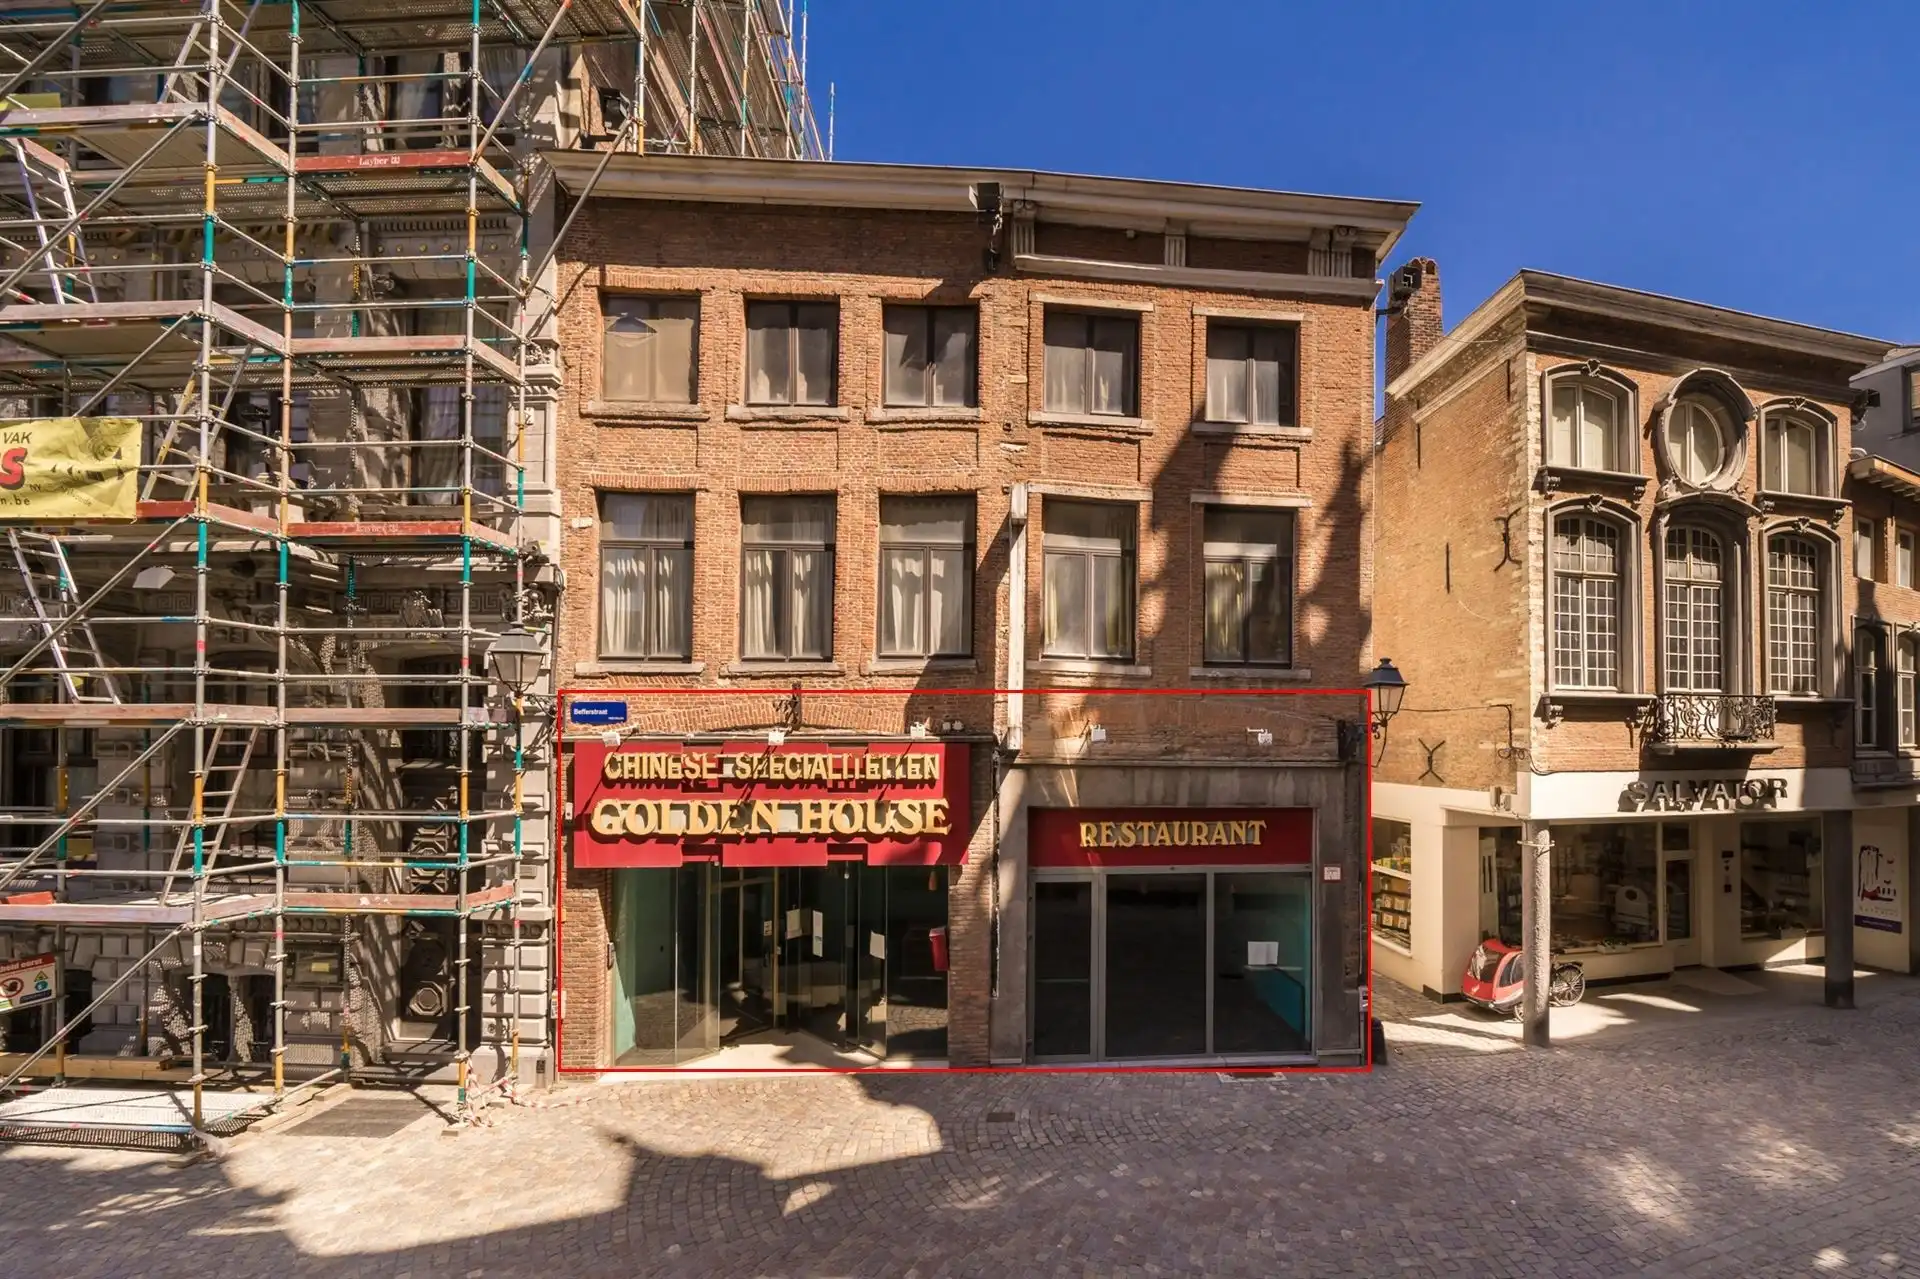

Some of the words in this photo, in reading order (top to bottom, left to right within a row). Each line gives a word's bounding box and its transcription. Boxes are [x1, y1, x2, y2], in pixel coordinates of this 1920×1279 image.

[3, 431, 33, 445] VAK
[604, 752, 719, 780] CHINESE
[1627, 777, 1788, 804] SALVATOR
[591, 798, 780, 836] GOLDEN
[801, 797, 953, 836] HOUSE
[1079, 819, 1268, 848] RESTAURANT
